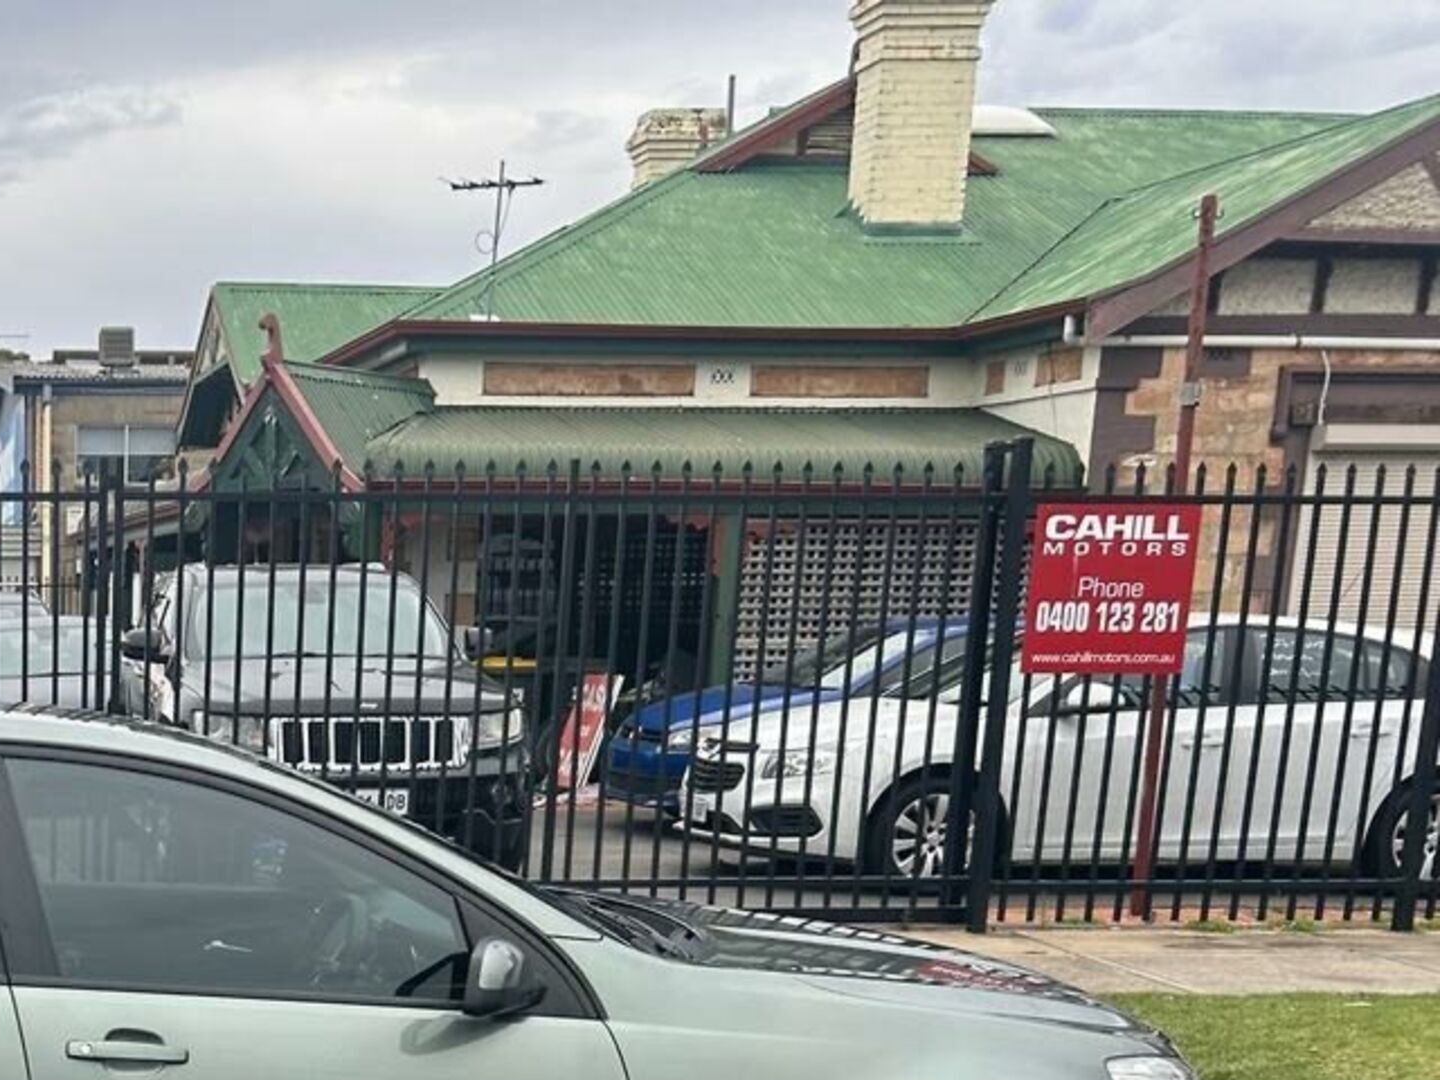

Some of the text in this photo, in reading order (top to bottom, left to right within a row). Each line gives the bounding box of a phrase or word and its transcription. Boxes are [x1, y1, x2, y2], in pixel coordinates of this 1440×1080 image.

[1045, 514, 1190, 541] CAHILL
[1043, 542, 1187, 556] MOTORS
[1077, 577, 1144, 597] Phone
[1035, 602, 1180, 633] 0400 123 281
[1031, 653, 1176, 664] www.cahillmotors.com.au
